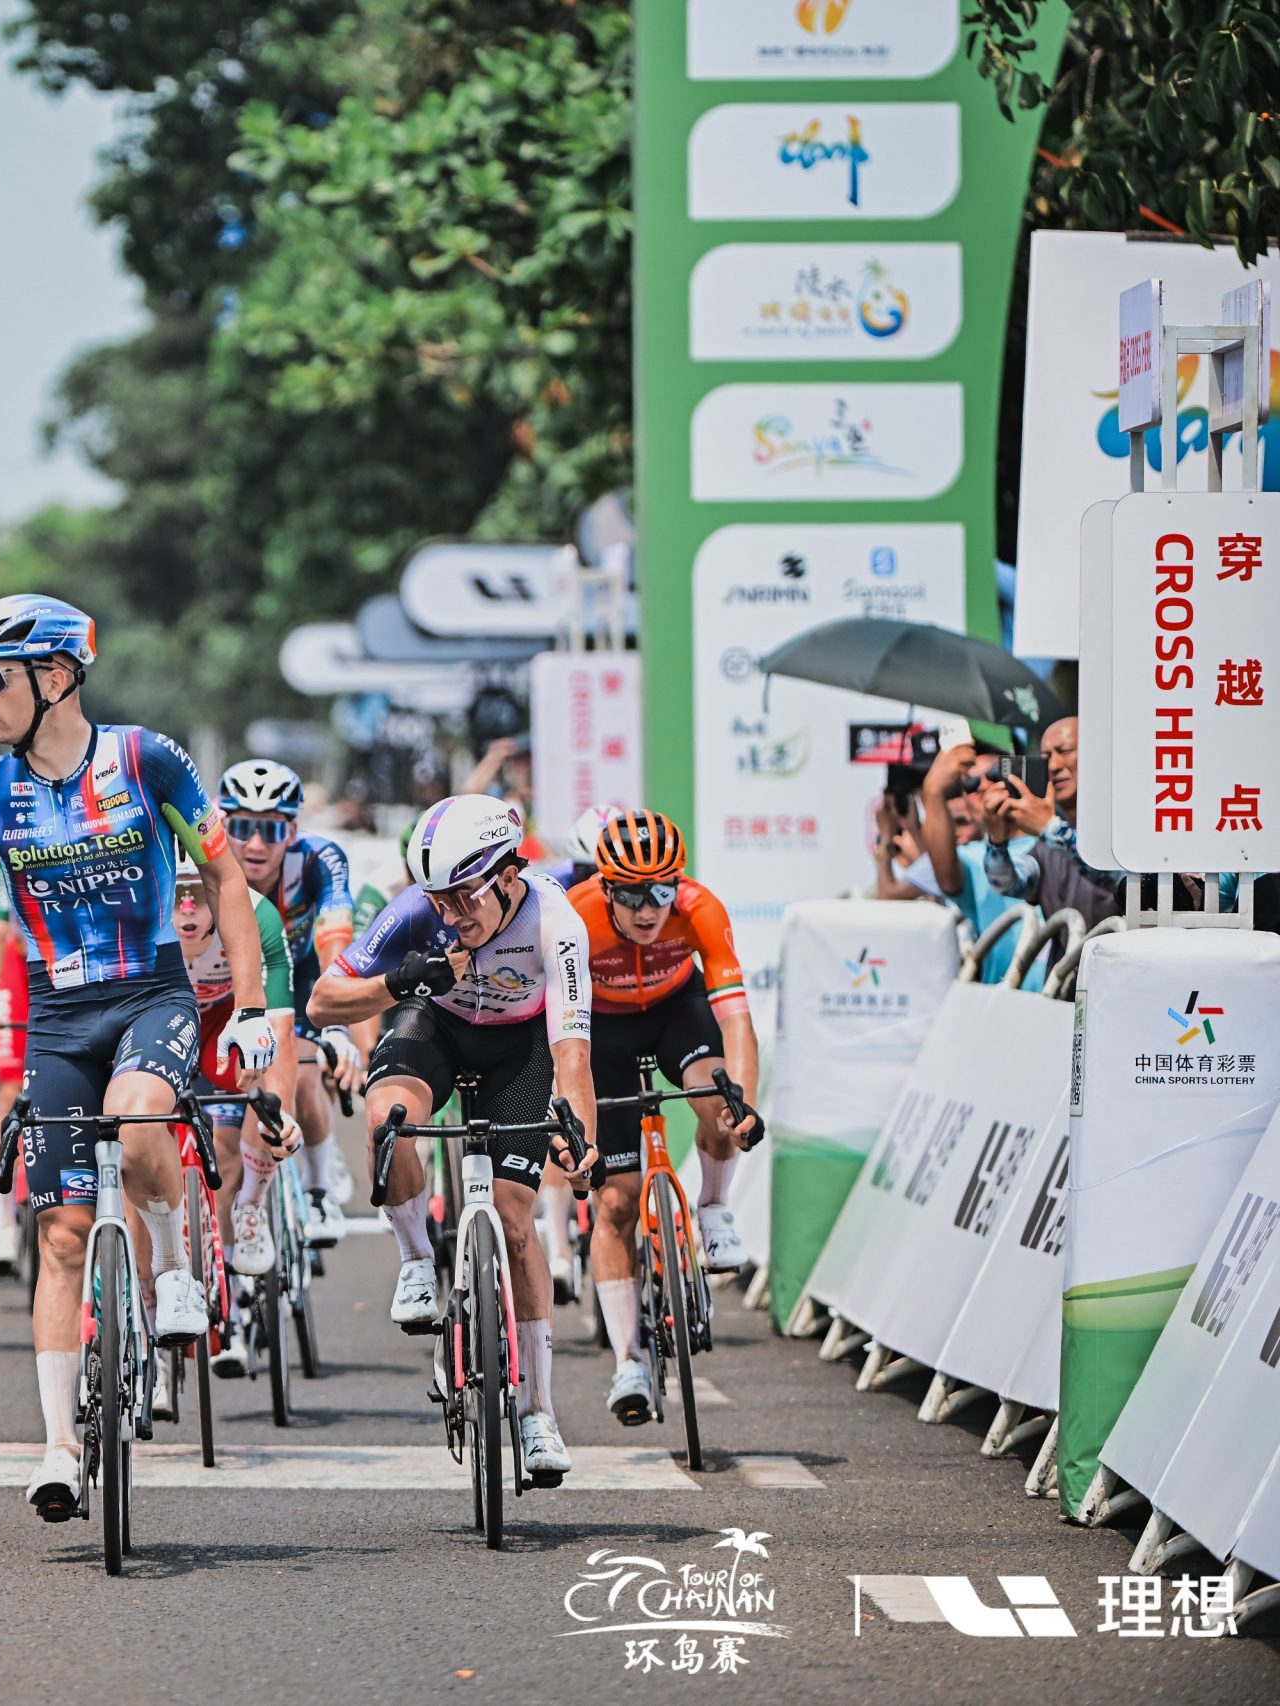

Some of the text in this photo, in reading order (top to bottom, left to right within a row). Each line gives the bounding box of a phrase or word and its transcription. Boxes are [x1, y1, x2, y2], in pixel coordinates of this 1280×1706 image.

[1155, 534, 1194, 832] CROSS HERE
[1215, 533, 1263, 832] 穿越点
[80, 806, 144, 831] NUOVACOMAUTO
[2, 826, 55, 841] ELITEWHEELS
[8, 828, 144, 868] Solution Tech
[95, 851, 109, 859] alta
[111, 844, 145, 856] efficienza
[57, 866, 144, 896] NIPPO
[366, 914, 396, 955] CORTIZO
[564, 958, 579, 1002] CORTIZO
[1135, 1054, 1256, 1073] 中国体育彩票
[1135, 1076, 1256, 1085] CHINA SPORTS LOTTERY
[469, 1184, 489, 1193] BH
